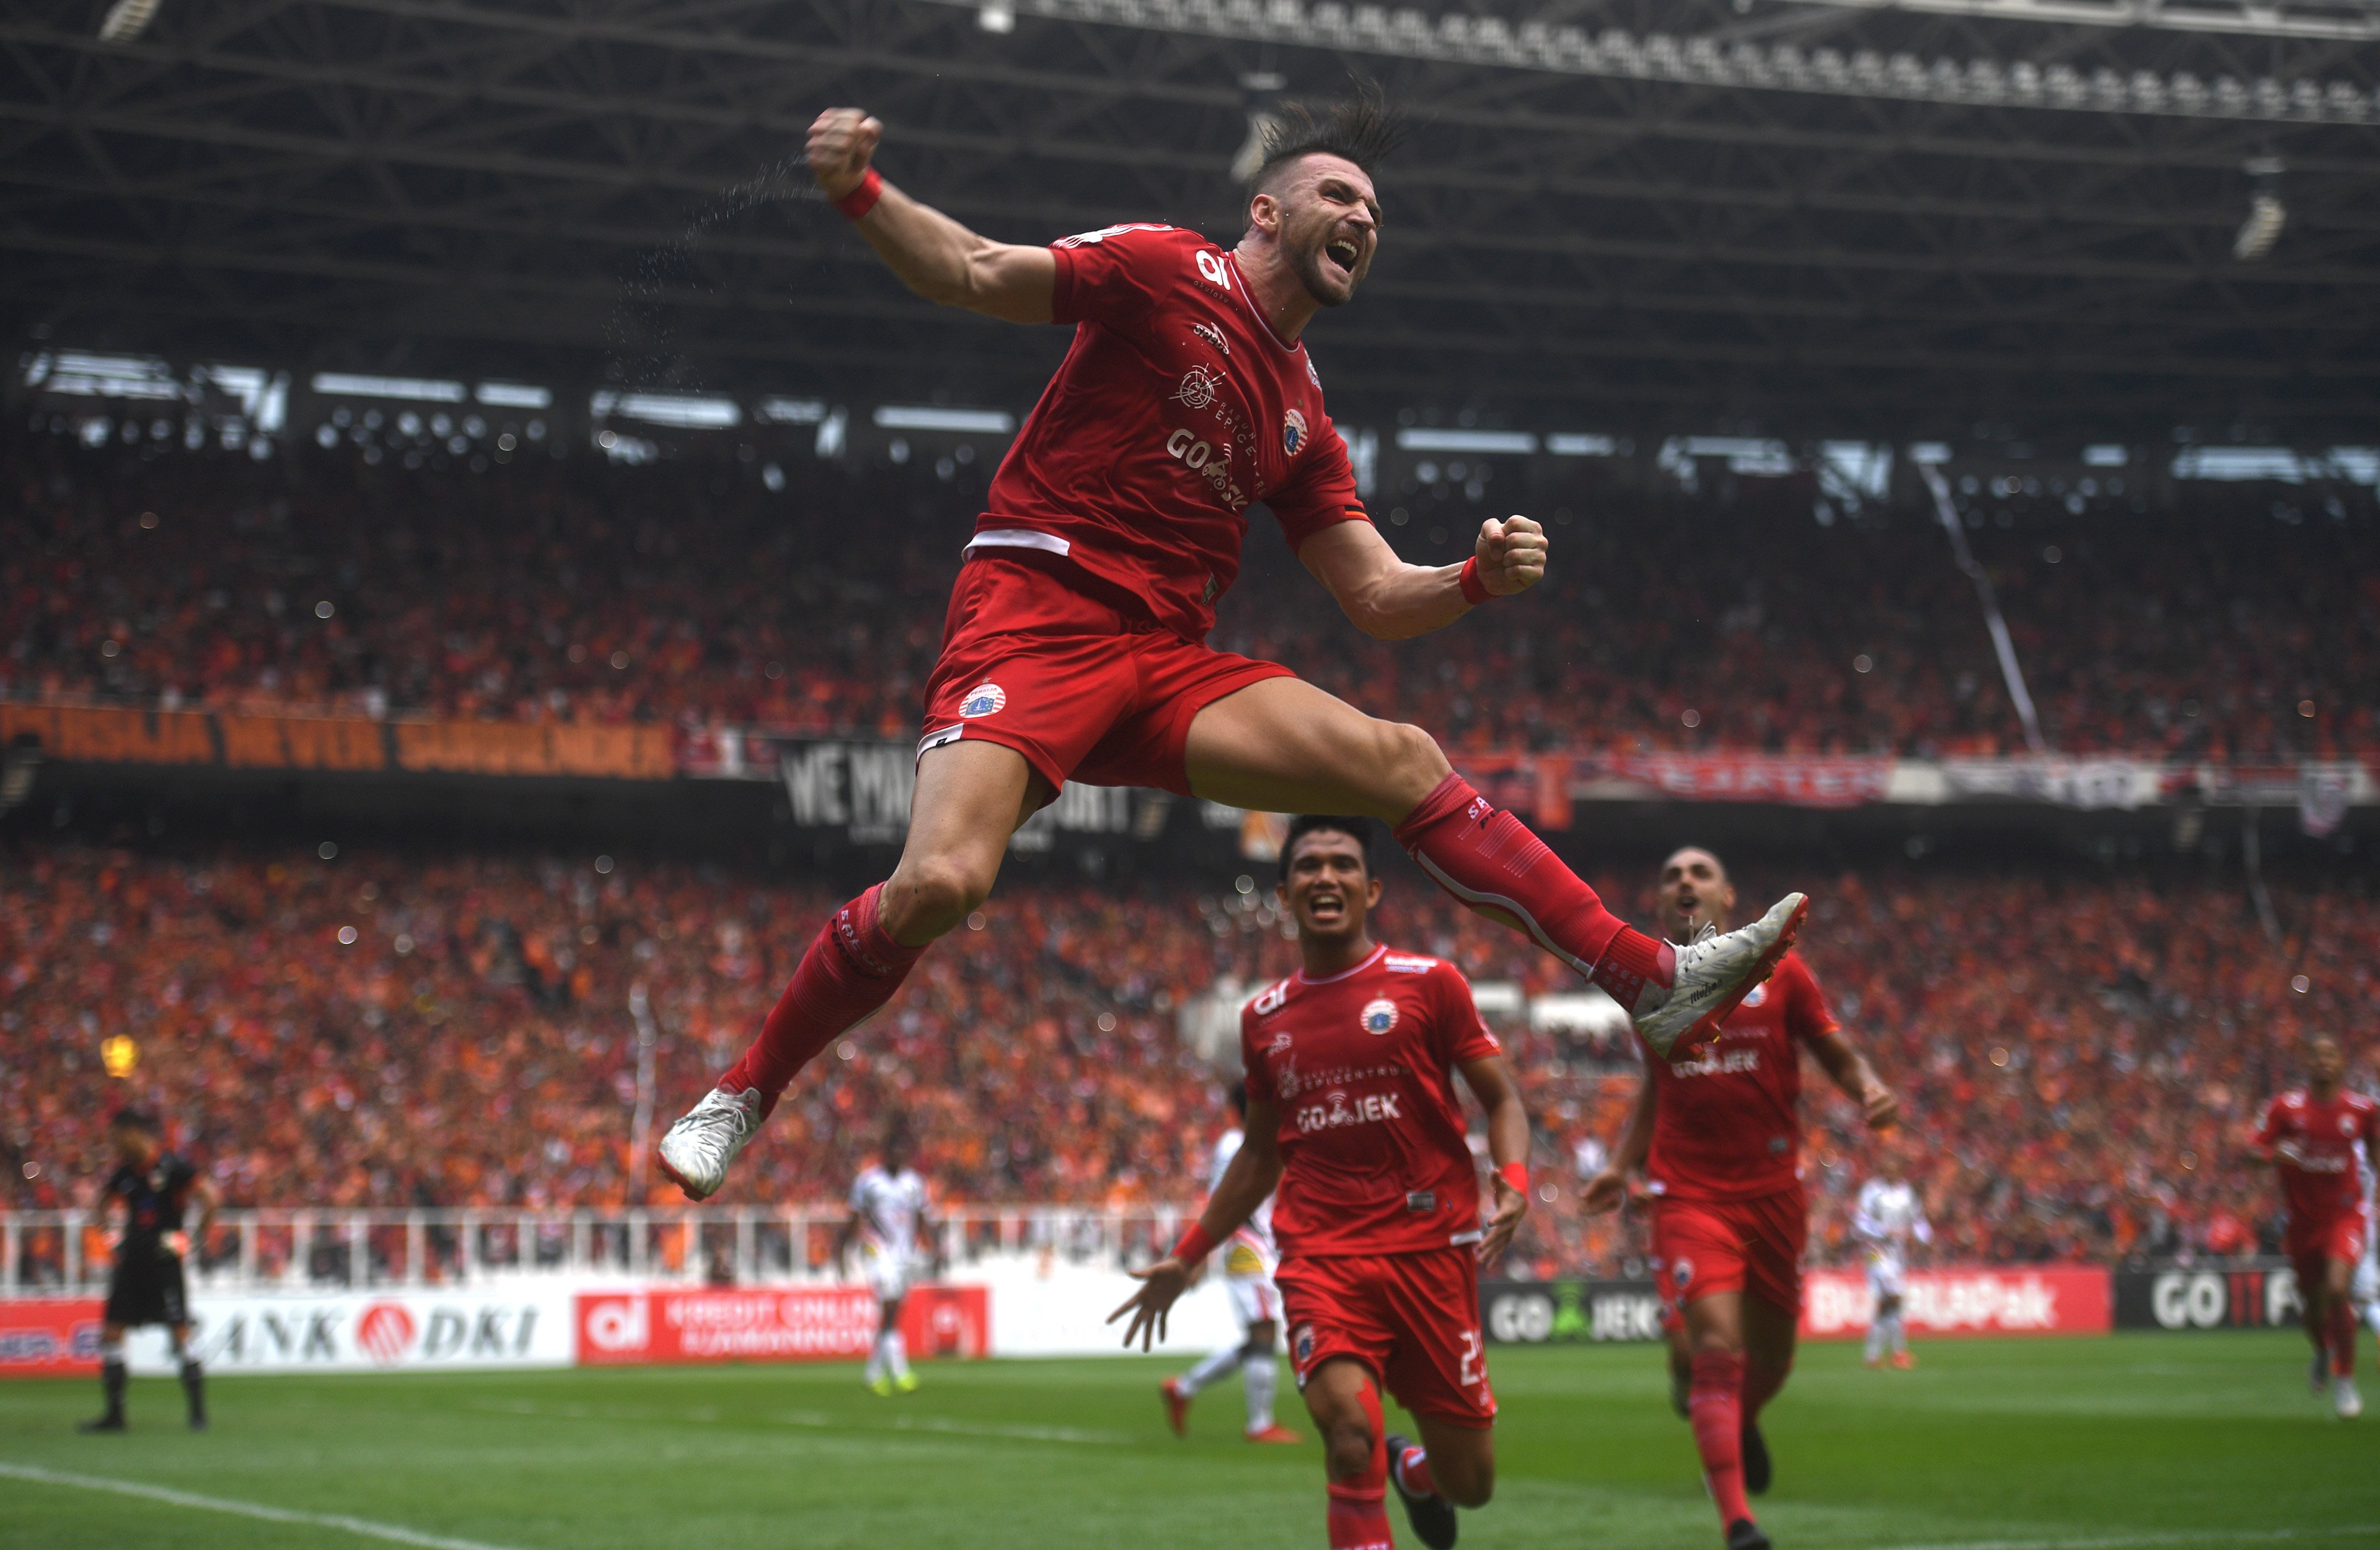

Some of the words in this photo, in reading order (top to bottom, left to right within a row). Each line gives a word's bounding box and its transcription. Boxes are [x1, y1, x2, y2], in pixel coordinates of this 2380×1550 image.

[1194, 280, 1229, 303] akulaku
[1193, 325, 1229, 355] SPECS
[970, 687, 998, 697] PERSIJA
[2152, 1267, 2226, 1329] GO
[178, 1306, 347, 1362] ANK
[422, 1306, 539, 1360] DKI
